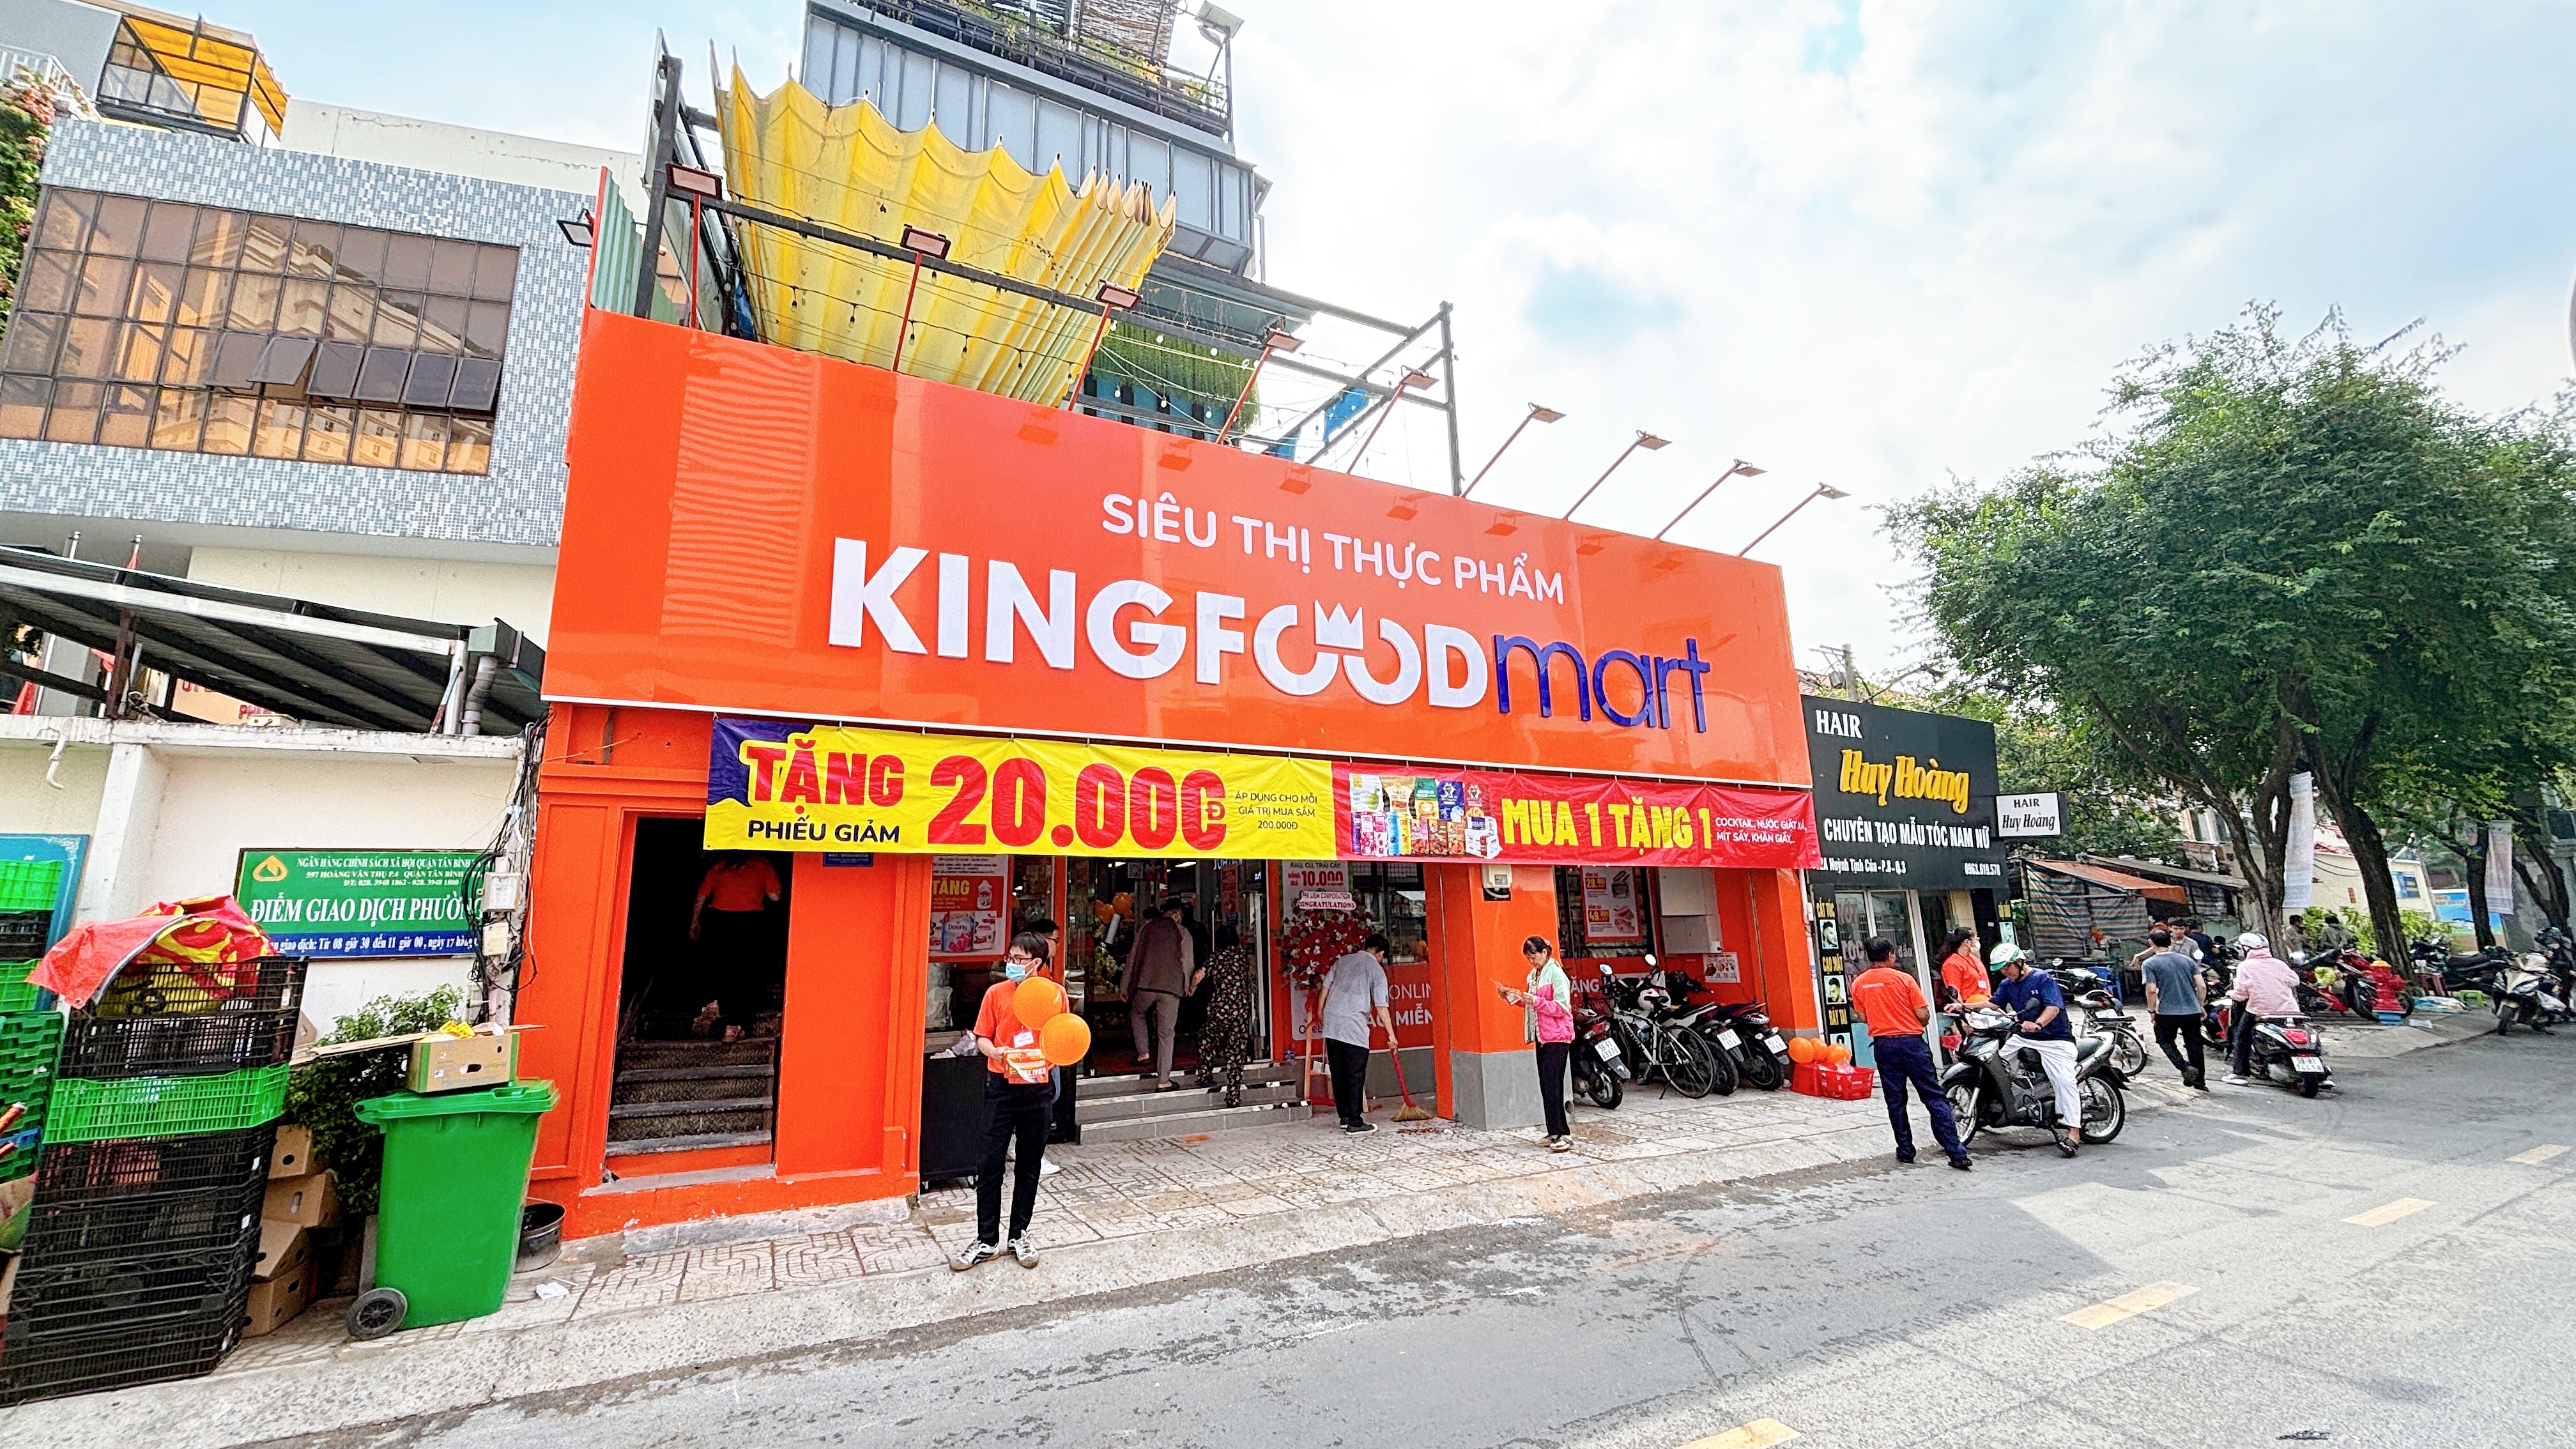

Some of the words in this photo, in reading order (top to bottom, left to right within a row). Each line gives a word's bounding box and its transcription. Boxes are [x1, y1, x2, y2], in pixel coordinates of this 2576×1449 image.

[1102, 491, 1216, 548] SIÊU
[1231, 515, 1310, 574] THỊ
[1323, 532, 1441, 589] THỰC
[1453, 552, 1563, 604] PHẨM
[1815, 710, 1863, 739] HAIR
[746, 739, 905, 815] TẶNG
[1839, 749, 1893, 807] Huy
[1894, 755, 1970, 814] Hoàng
[1235, 790, 1248, 801] ÁP
[1250, 793, 1276, 803] DỤNG
[1279, 793, 1298, 802] CHO
[1300, 792, 1317, 804] MỖI
[2014, 799, 2040, 808] HAIR
[1238, 804, 1254, 815] GIÁ
[1256, 806, 1271, 817] TRỊ
[1273, 807, 1294, 816] MUA
[748, 815, 826, 841] PHIẾU
[834, 820, 900, 843] GIẢM
[1258, 820, 1298, 829] 200.000Đ
[1501, 799, 1579, 845] MUA
[1584, 802, 1602, 846] 1
[1608, 796, 1693, 855] TẶNG
[1698, 808, 1712, 848] 1
[1715, 817, 1756, 829] COCKTAIL,
[1757, 818, 1779, 829] NƯỚC
[2002, 815, 2021, 832] Huy
[2023, 812, 2055, 831] Hoàng
[1717, 830, 1731, 841] MÍT
[1751, 831, 1774, 843] KHĂN
[1824, 816, 1873, 843] CHUYÊN
[1874, 822, 1897, 847] TẠO
[1899, 816, 1926, 846] MẪU
[1926, 820, 1949, 847] TÓC
[1949, 826, 1974, 848] NAM
[1975, 825, 1989, 848] NỮ
[298, 855, 319, 867] NGÂN
[320, 855, 342, 867] HÀNG
[343, 856, 368, 867] CHÍNH
[369, 856, 389, 867] SÁCH
[389, 857, 401, 867] XÃ
[401, 857, 415, 869] HỘI
[416, 857, 437, 869] QUẬN
[438, 857, 452, 867] TÂN
[453, 856, 471, 867] BÌNH
[1829, 857, 1849, 874] Huỳnh
[1850, 858, 1864, 874] Tịnh
[352, 870, 369, 878] VĂN
[371, 871, 387, 879] THỤ
[251, 892, 302, 923] ĐIỂM
[306, 898, 355, 923] GIAO
[358, 898, 405, 927] DỊCH
[280, 939, 297, 952] giao
[333, 938, 342, 949] 08
[360, 937, 370, 949] 30
[372, 933, 387, 949] đến
[387, 937, 396, 948] 11
[428, 935, 445, 951] ngày
[447, 939, 454, 947] 17
